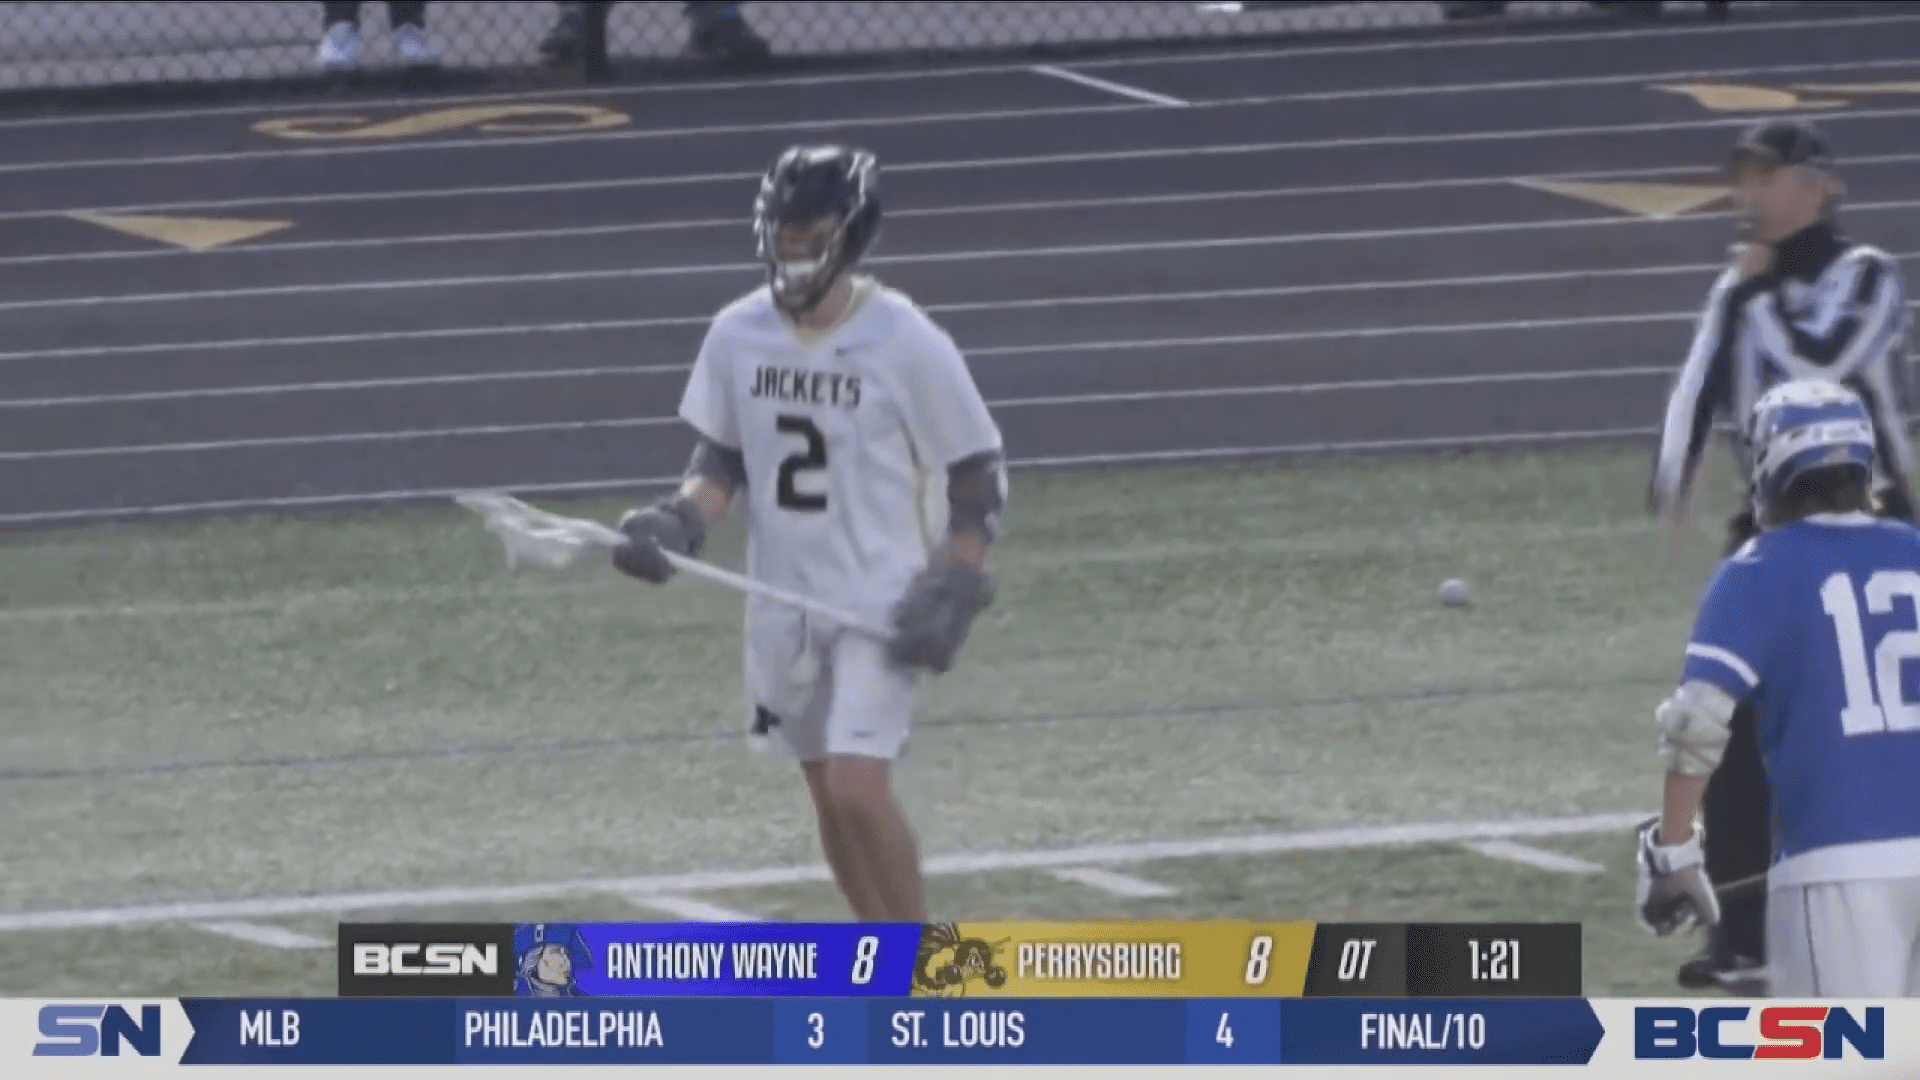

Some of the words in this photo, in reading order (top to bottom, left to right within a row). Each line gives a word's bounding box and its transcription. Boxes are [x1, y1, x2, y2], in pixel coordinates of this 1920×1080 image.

[749, 364, 862, 408] JACKETS
[776, 414, 828, 512] 2
[1820, 570, 1920, 736] 12
